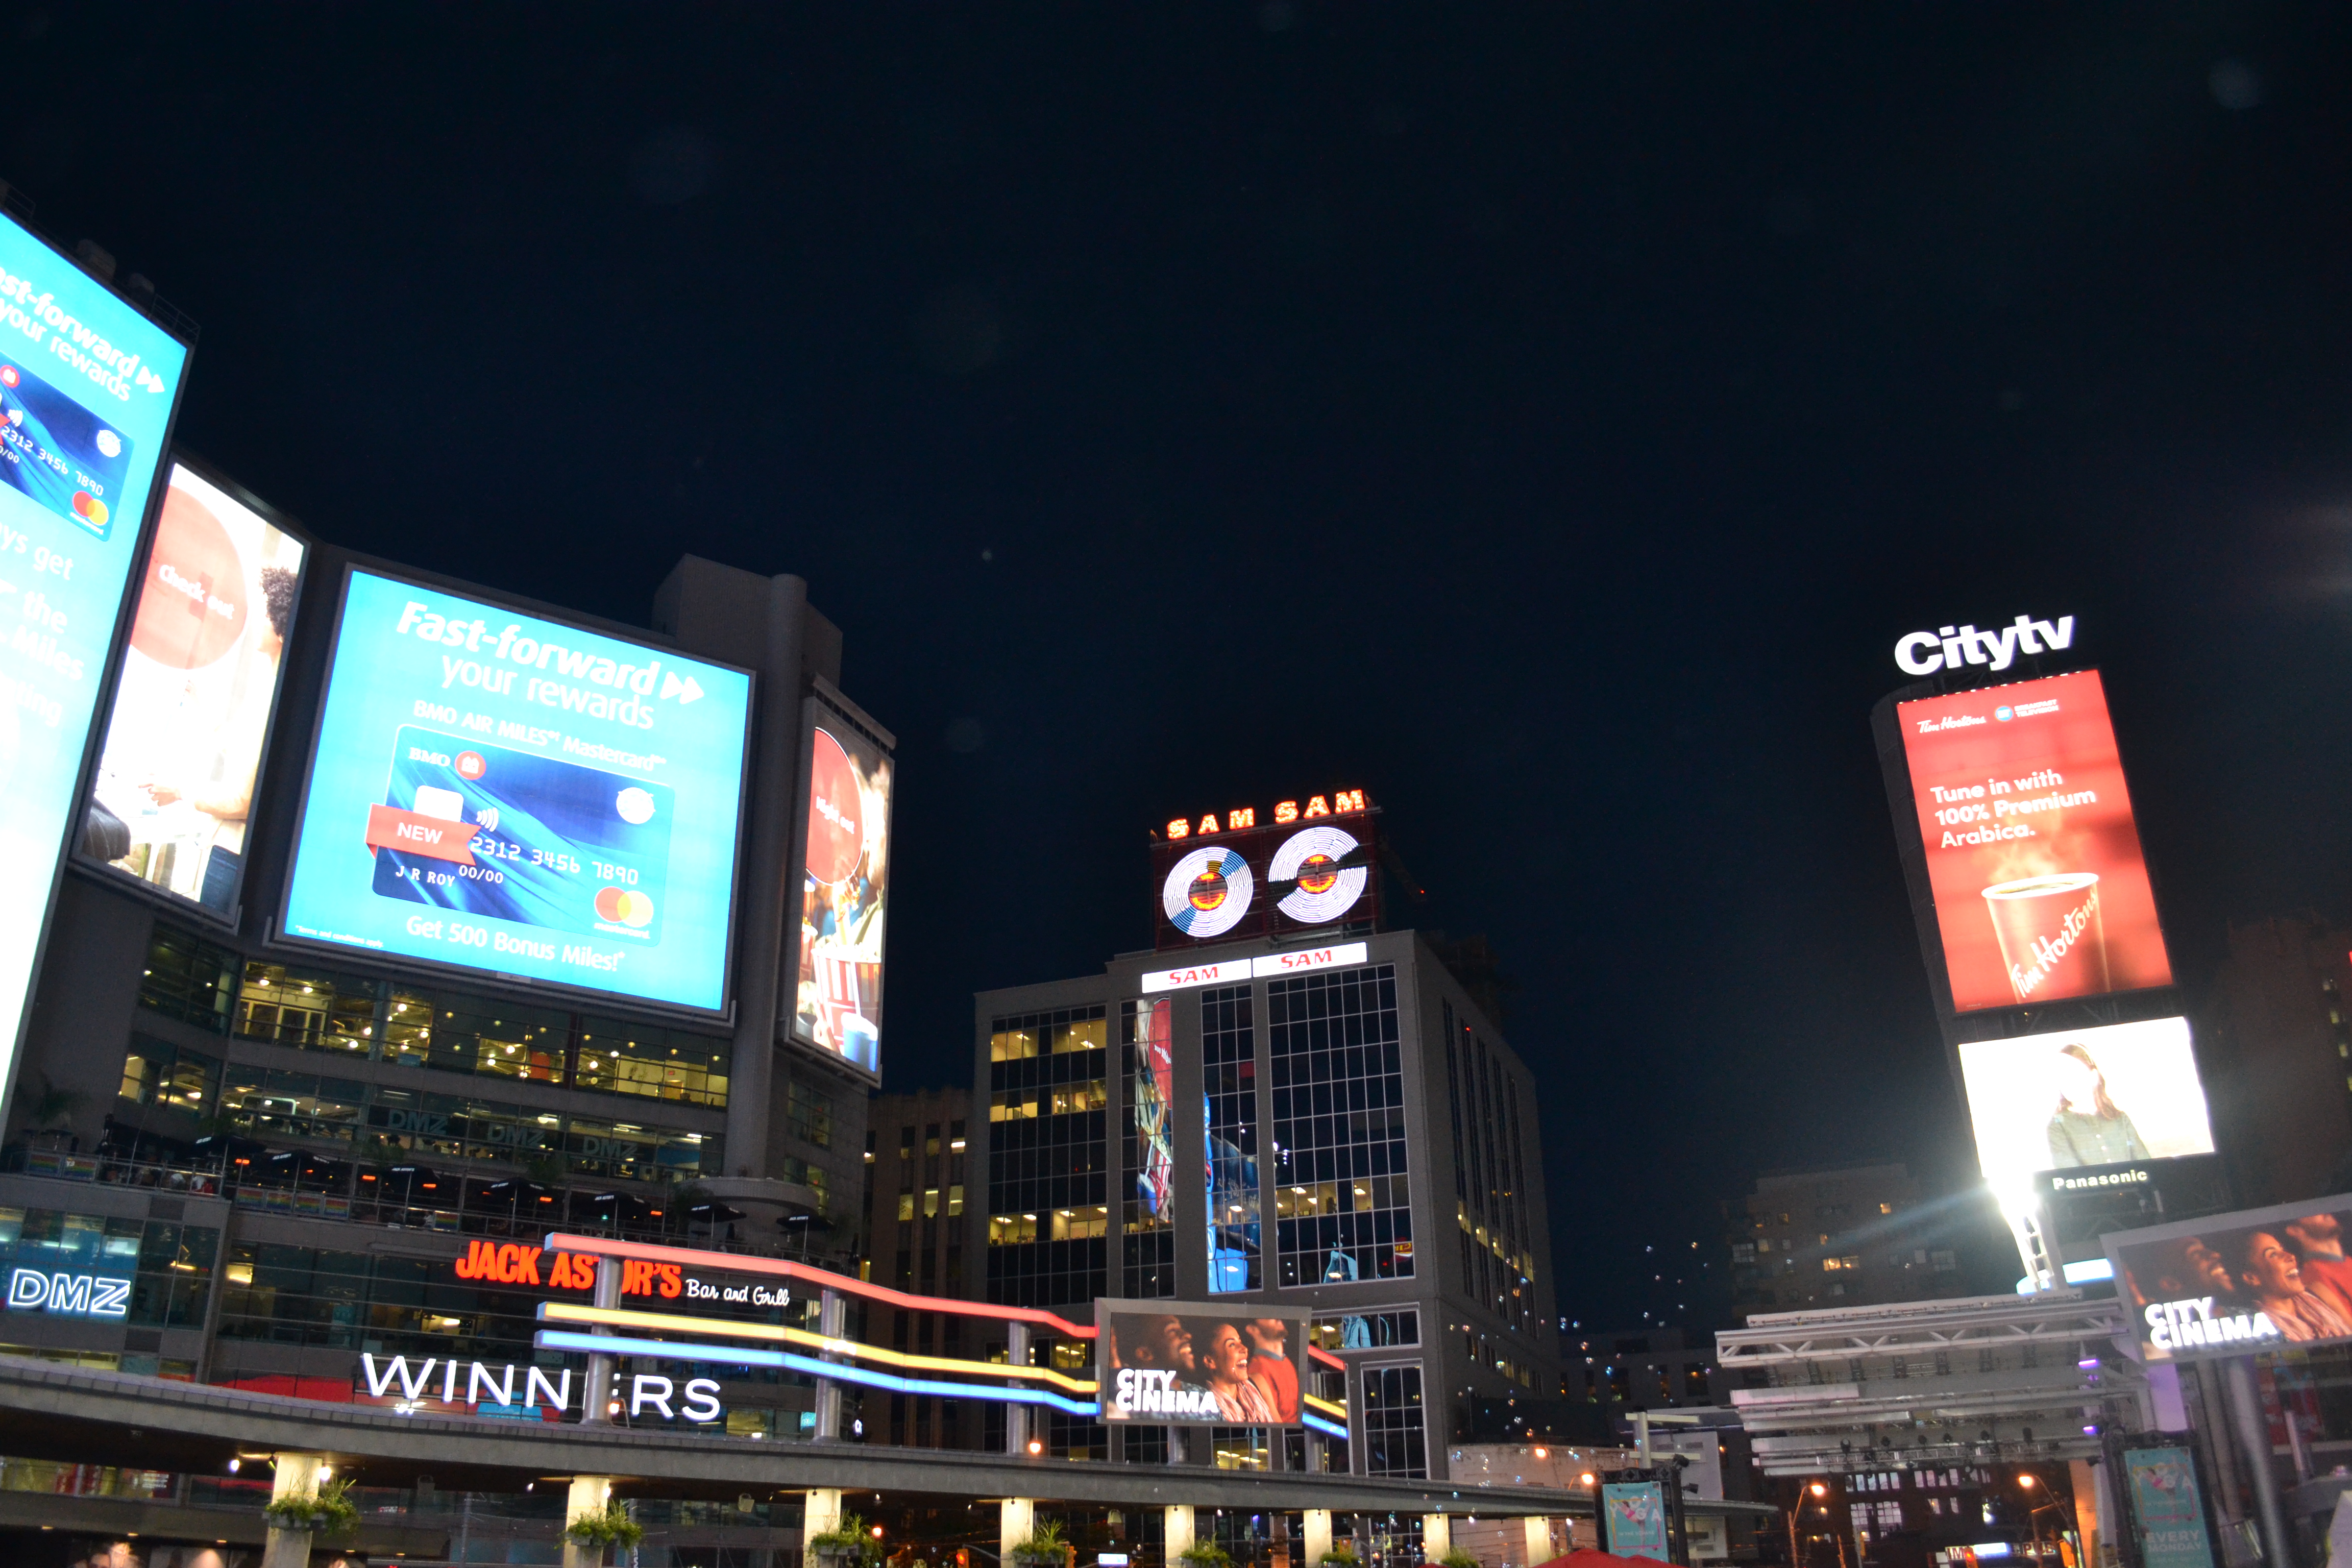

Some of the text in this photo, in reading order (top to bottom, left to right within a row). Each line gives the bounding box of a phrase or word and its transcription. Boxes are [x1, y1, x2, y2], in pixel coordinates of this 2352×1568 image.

[50, 336, 131, 401] rewards
[38, 448, 68, 474] 3456
[76, 471, 104, 496] 7890
[33, 546, 74, 581] get
[159, 565, 205, 603] Check
[22, 590, 68, 634] the
[11, 624, 85, 681] Miles
[397, 601, 660, 695] Fast-forward
[1895, 615, 2073, 675] Citytv
[442, 656, 654, 729] your rewards
[2014, 699, 2056, 712] BREAKFAST
[414, 700, 457, 724] BMO
[461, 713, 491, 733] AIR
[1917, 715, 1987, 733] Tim Hortons
[2015, 705, 2059, 717] TELEVISION
[408, 747, 450, 766] BMO
[1930, 769, 2063, 803] Tune in with
[1167, 789, 1365, 839] SAM SAM
[1935, 791, 2096, 826] 100% Premium
[398, 822, 443, 844] NEW
[1941, 824, 2036, 848] Arabica.
[396, 866, 455, 887] J R ROY
[459, 865, 503, 884] 00/00
[470, 837, 639, 885] 2312 3456 7890
[406, 916, 443, 939] Get
[448, 923, 487, 947] 500
[494, 932, 555, 960] Bonus
[1169, 950, 1333, 985] SAM SAM
[388, 1109, 448, 1134] DMZ
[487, 1122, 547, 1148] DMZ
[582, 1135, 639, 1160] DMZ
[2052, 1169, 2148, 1190] Panasonic
[455, 1240, 681, 1299] JACK ASR'S
[9, 1269, 131, 1315] DMZ
[685, 1279, 790, 1307] Bar and Grill
[2145, 1296, 2213, 1328] CITY
[2150, 1312, 2278, 1349] CINEMA
[363, 1353, 722, 1422] WINNRS
[1117, 1369, 1176, 1391] CITY
[1116, 1390, 1219, 1413] CINEMA
[2146, 1530, 2199, 1542] EVERY
[2148, 1542, 2201, 1552] MONDAY
